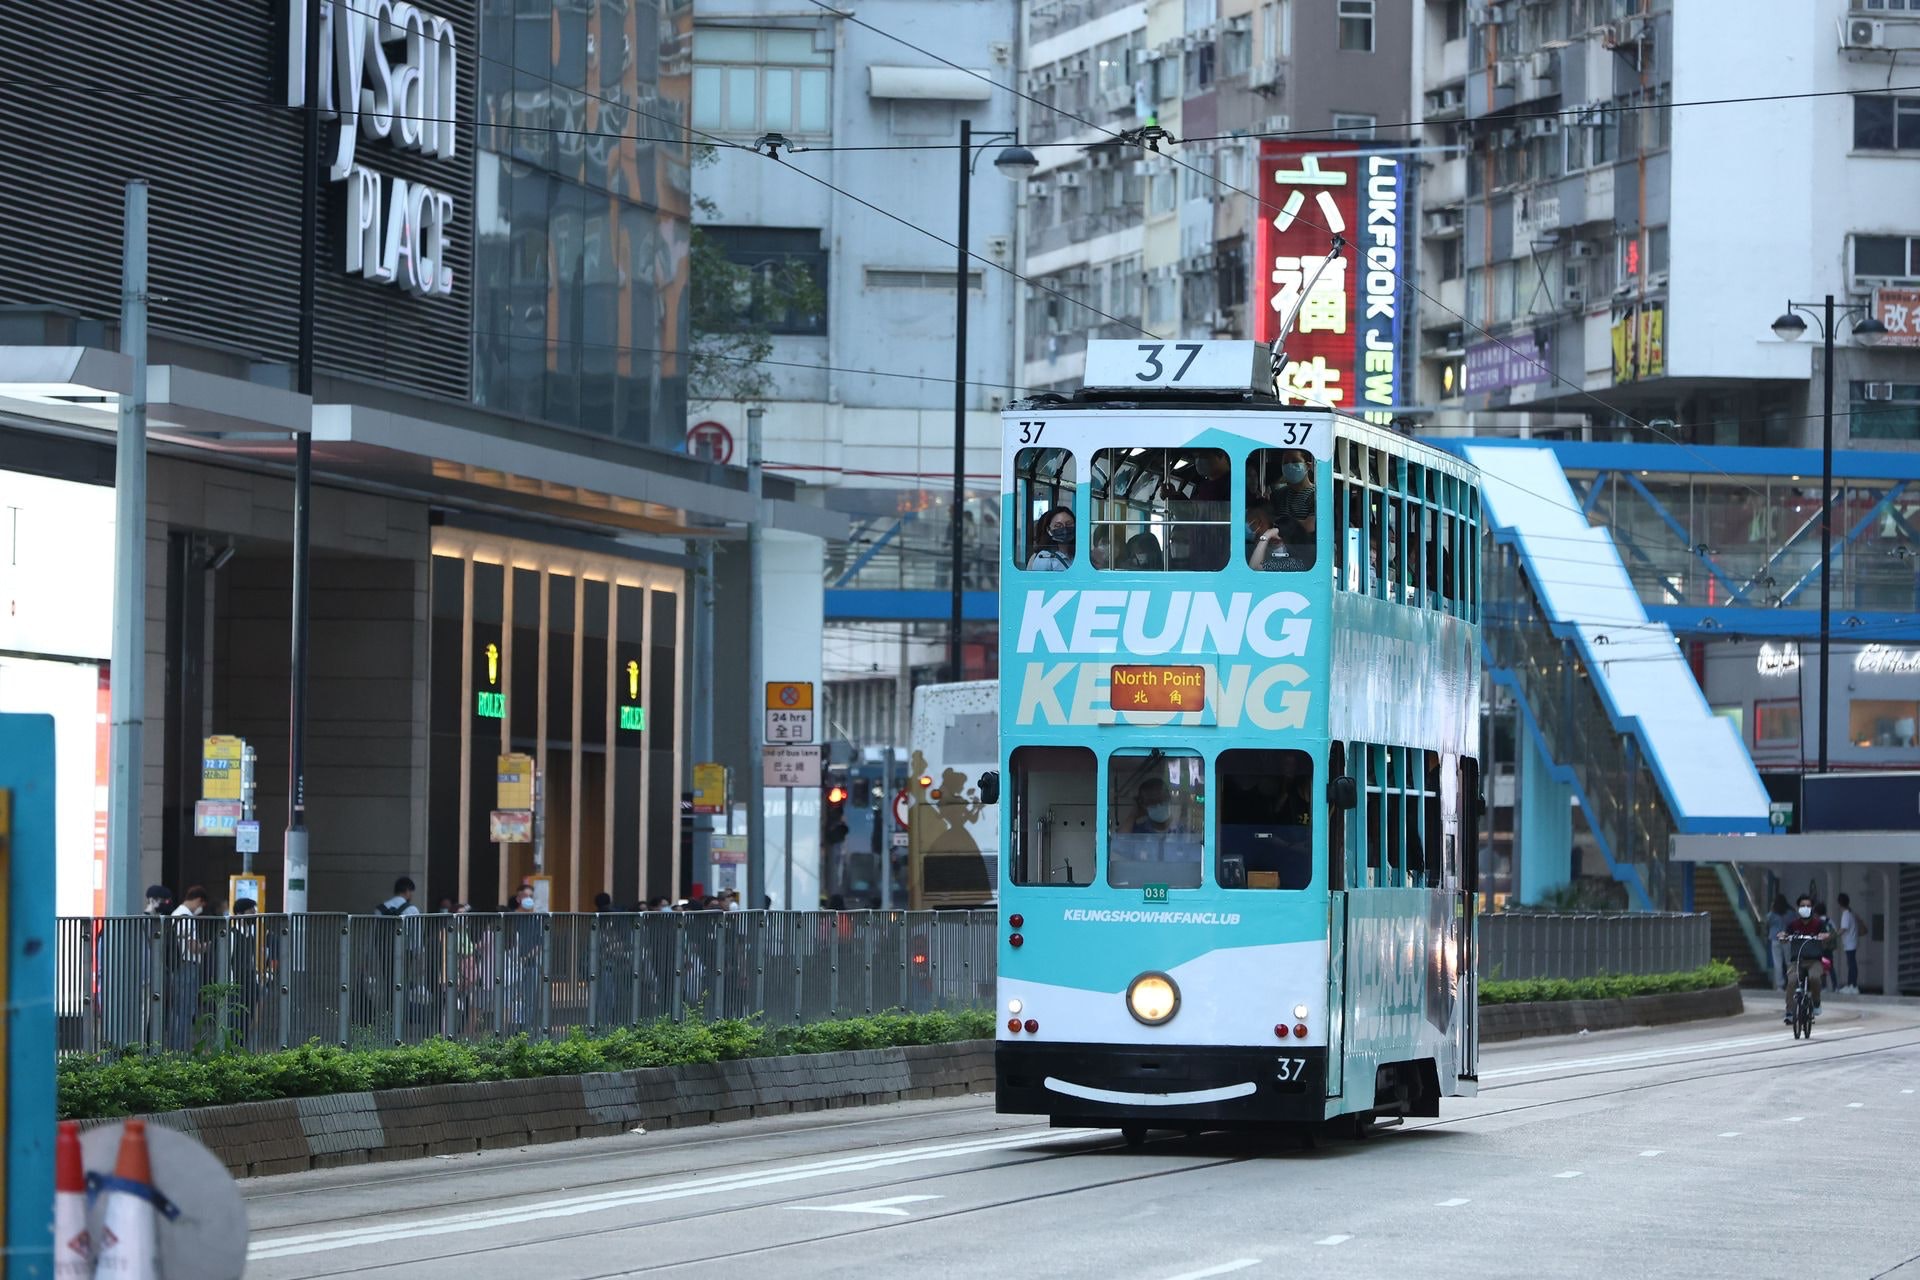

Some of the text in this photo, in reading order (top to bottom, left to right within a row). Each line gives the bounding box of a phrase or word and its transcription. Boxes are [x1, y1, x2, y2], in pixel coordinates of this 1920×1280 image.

[346, 165, 454, 297] PLACE
[1135, 343, 1204, 382] 37
[1018, 421, 1046, 444] 37
[1283, 422, 1313, 446] 37
[1016, 589, 1312, 658] KEUNG
[1114, 671, 1201, 687] North Point
[478, 691, 506, 719] ROLEX
[1016, 662, 1311, 731] KENG
[1133, 689, 1183, 706] 北角
[620, 705, 646, 731] ROLEX
[772, 713, 806, 722] 24 hrs
[776, 724, 803, 738] 全日
[1145, 887, 1166, 899] 038
[1063, 908, 1241, 925] KEUNGSHOWHKFANCLUB
[1276, 1058, 1306, 1082] 37
